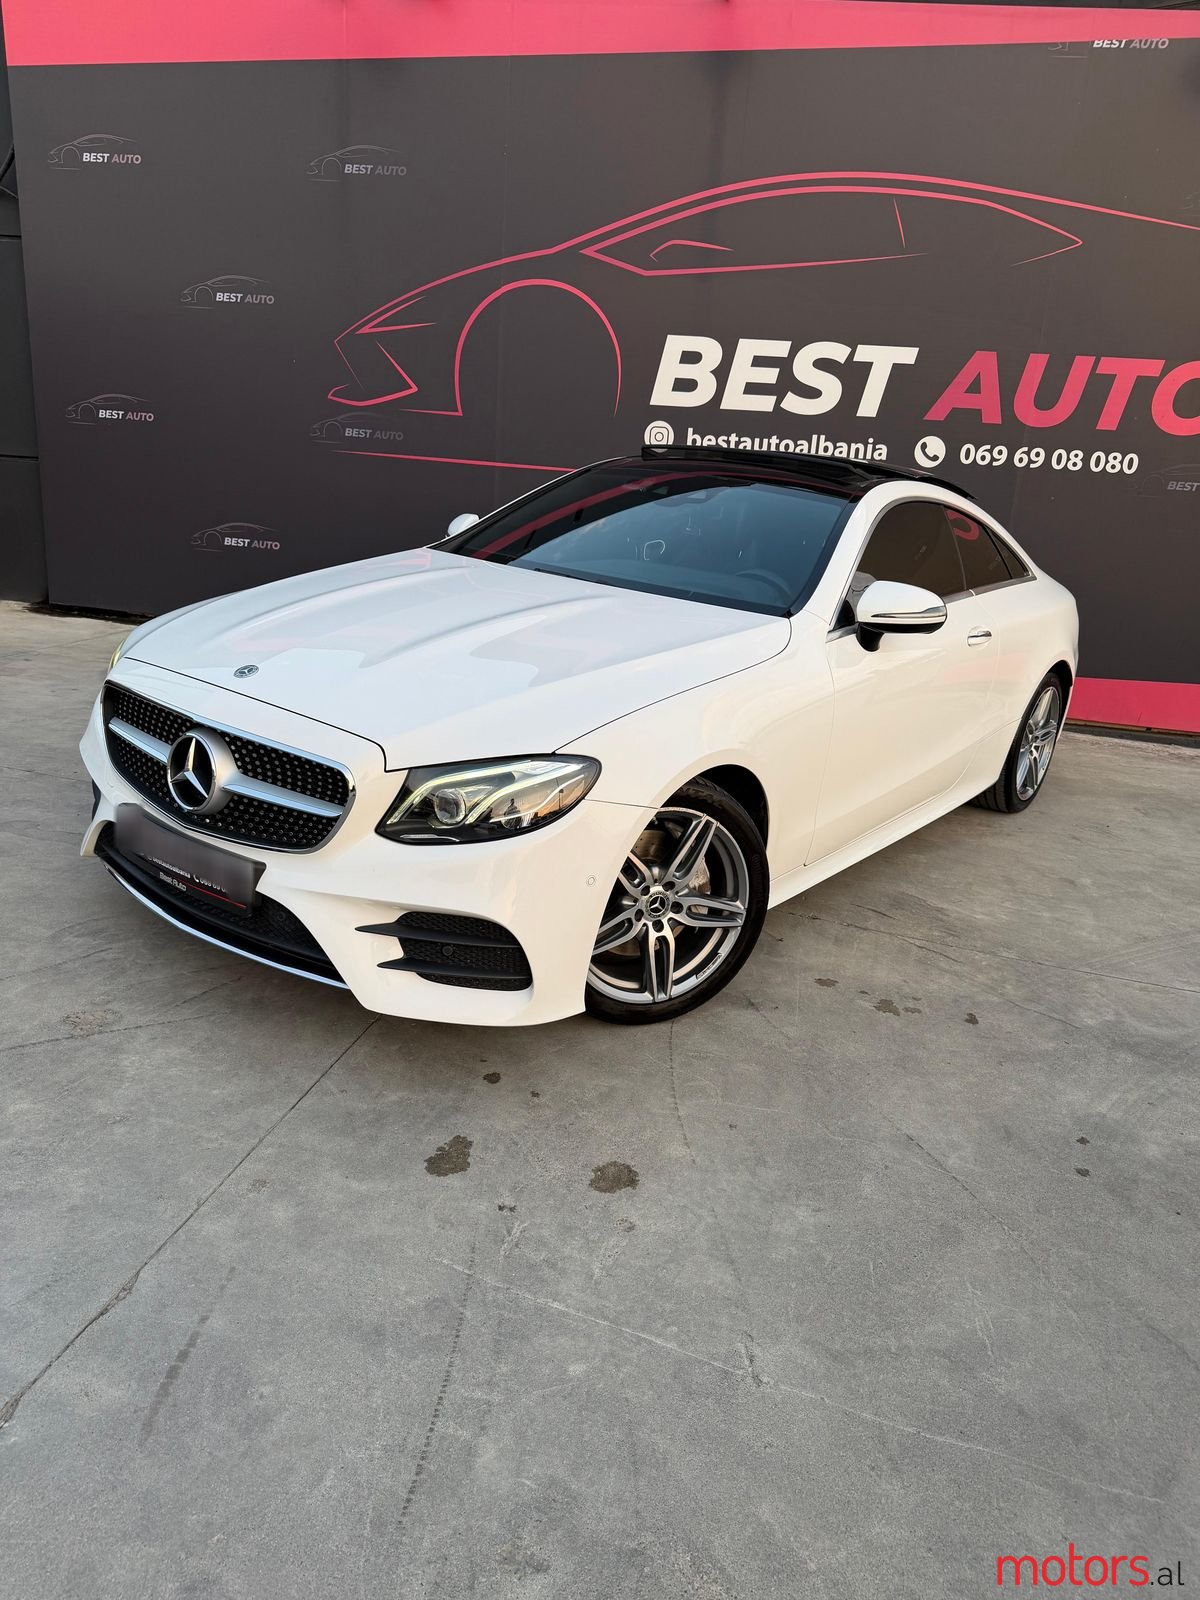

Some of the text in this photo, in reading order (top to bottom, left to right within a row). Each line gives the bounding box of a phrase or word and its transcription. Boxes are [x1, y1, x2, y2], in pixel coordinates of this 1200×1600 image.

[1129, 38, 1169, 49] AUTO
[81, 152, 142, 165] BEST AUTO
[344, 163, 407, 177] BEST AUTO
[215, 292, 275, 305] BEST AUTO
[650, 334, 920, 419] BEST
[98, 409, 155, 422] BEST AUTO
[344, 427, 404, 441] BEST AUTO
[686, 427, 889, 461] bestautoalbania
[959, 443, 1140, 475] 069 69 08 080
[1167, 481, 1200, 492] BEST
[223, 536, 281, 550] BEST AUTO
